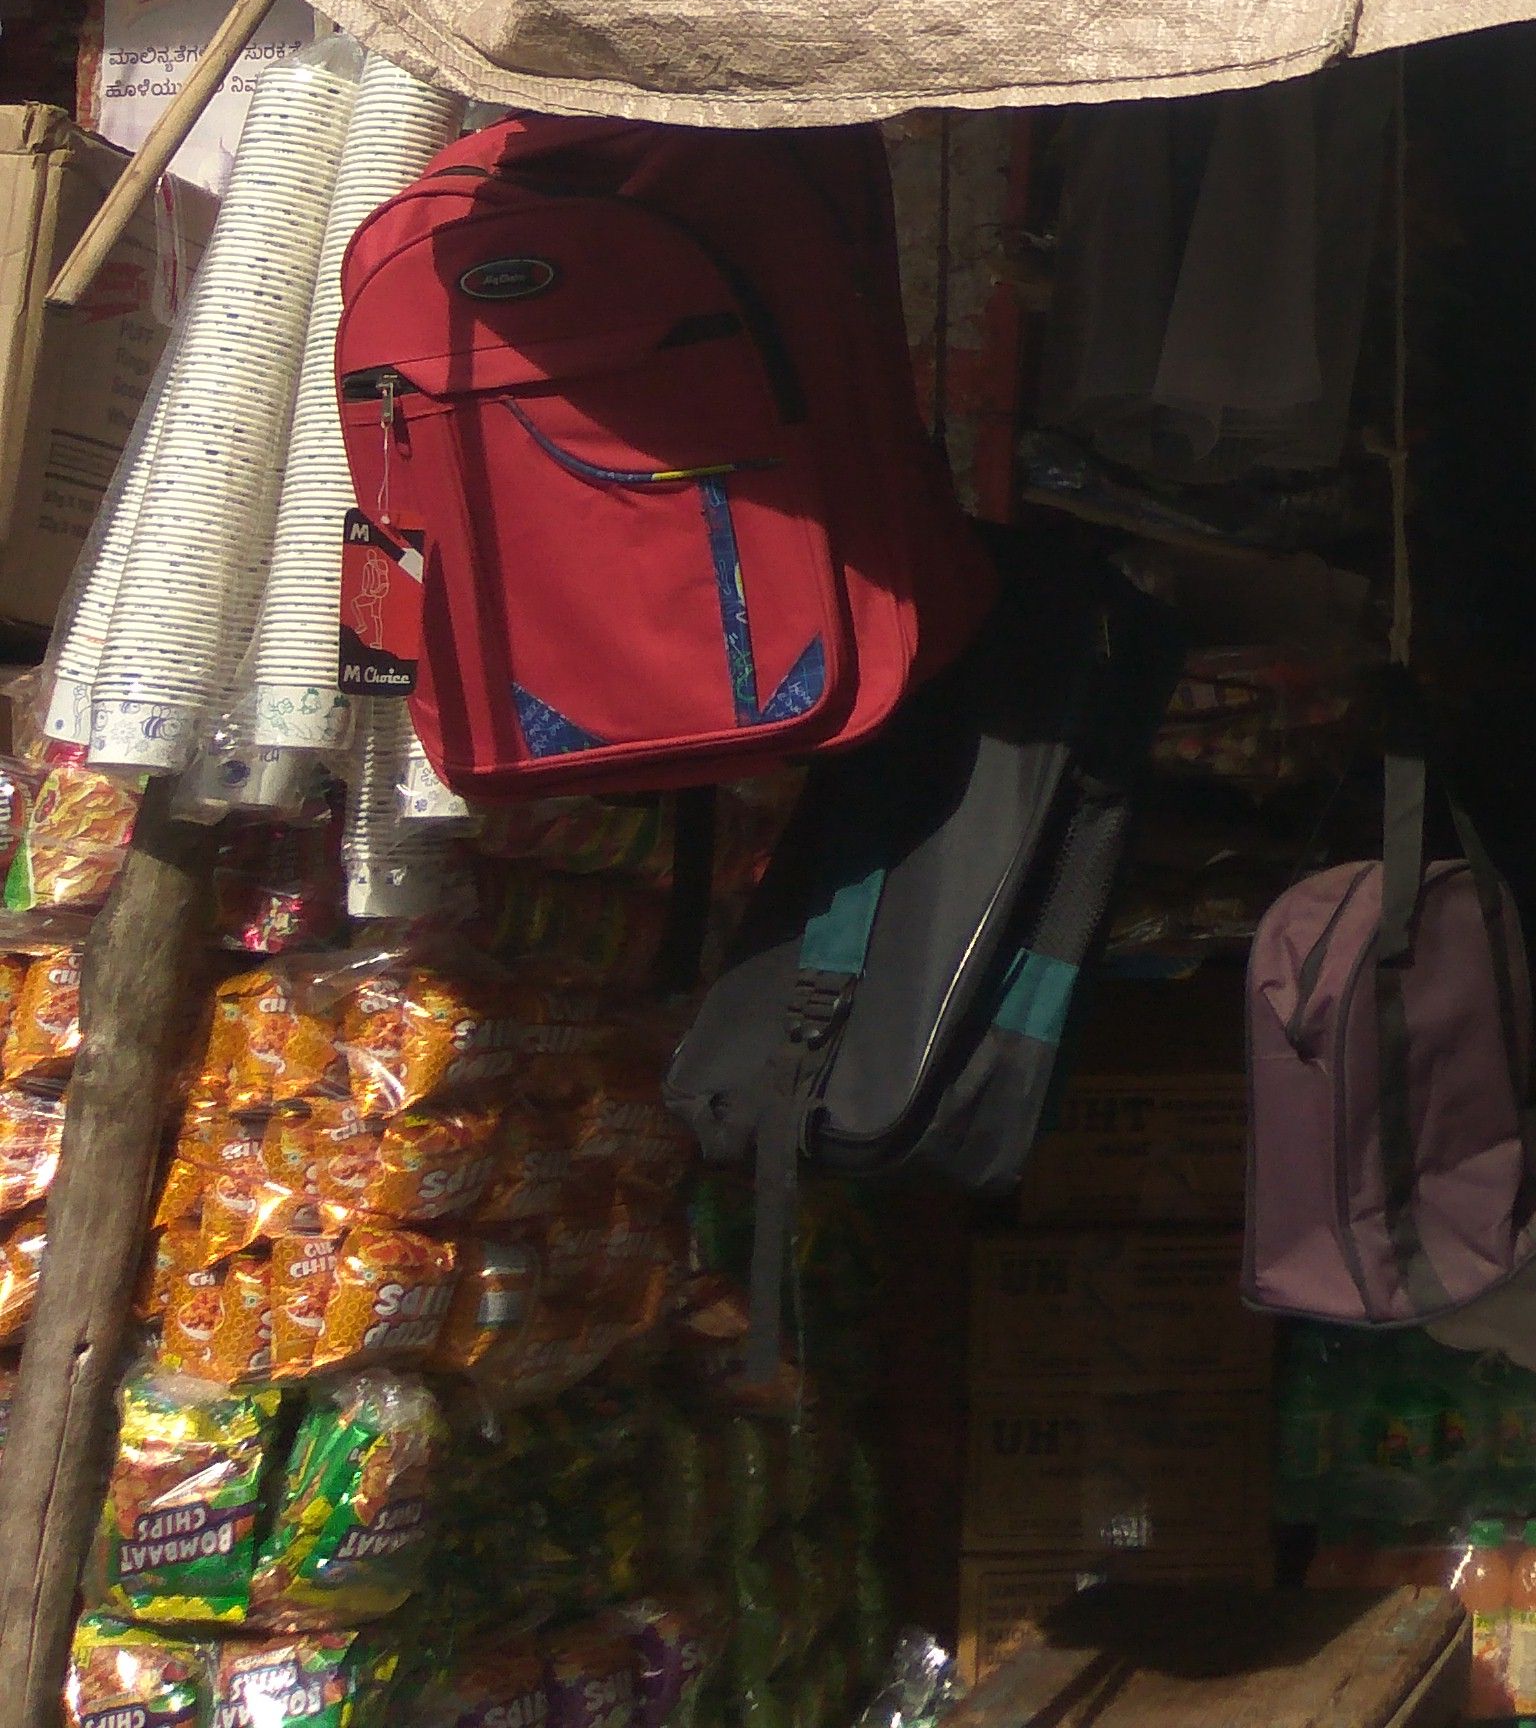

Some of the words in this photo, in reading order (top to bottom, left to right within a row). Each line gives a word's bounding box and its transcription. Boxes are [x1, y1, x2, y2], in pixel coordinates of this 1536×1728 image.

[350, 523, 369, 542] M
[344, 664, 360, 683] M
[364, 666, 411, 684] Choice
[290, 1255, 337, 1279] CHIP
[137, 1507, 207, 1541] CHIPS
[120, 1522, 235, 1573] BOMBAAT
